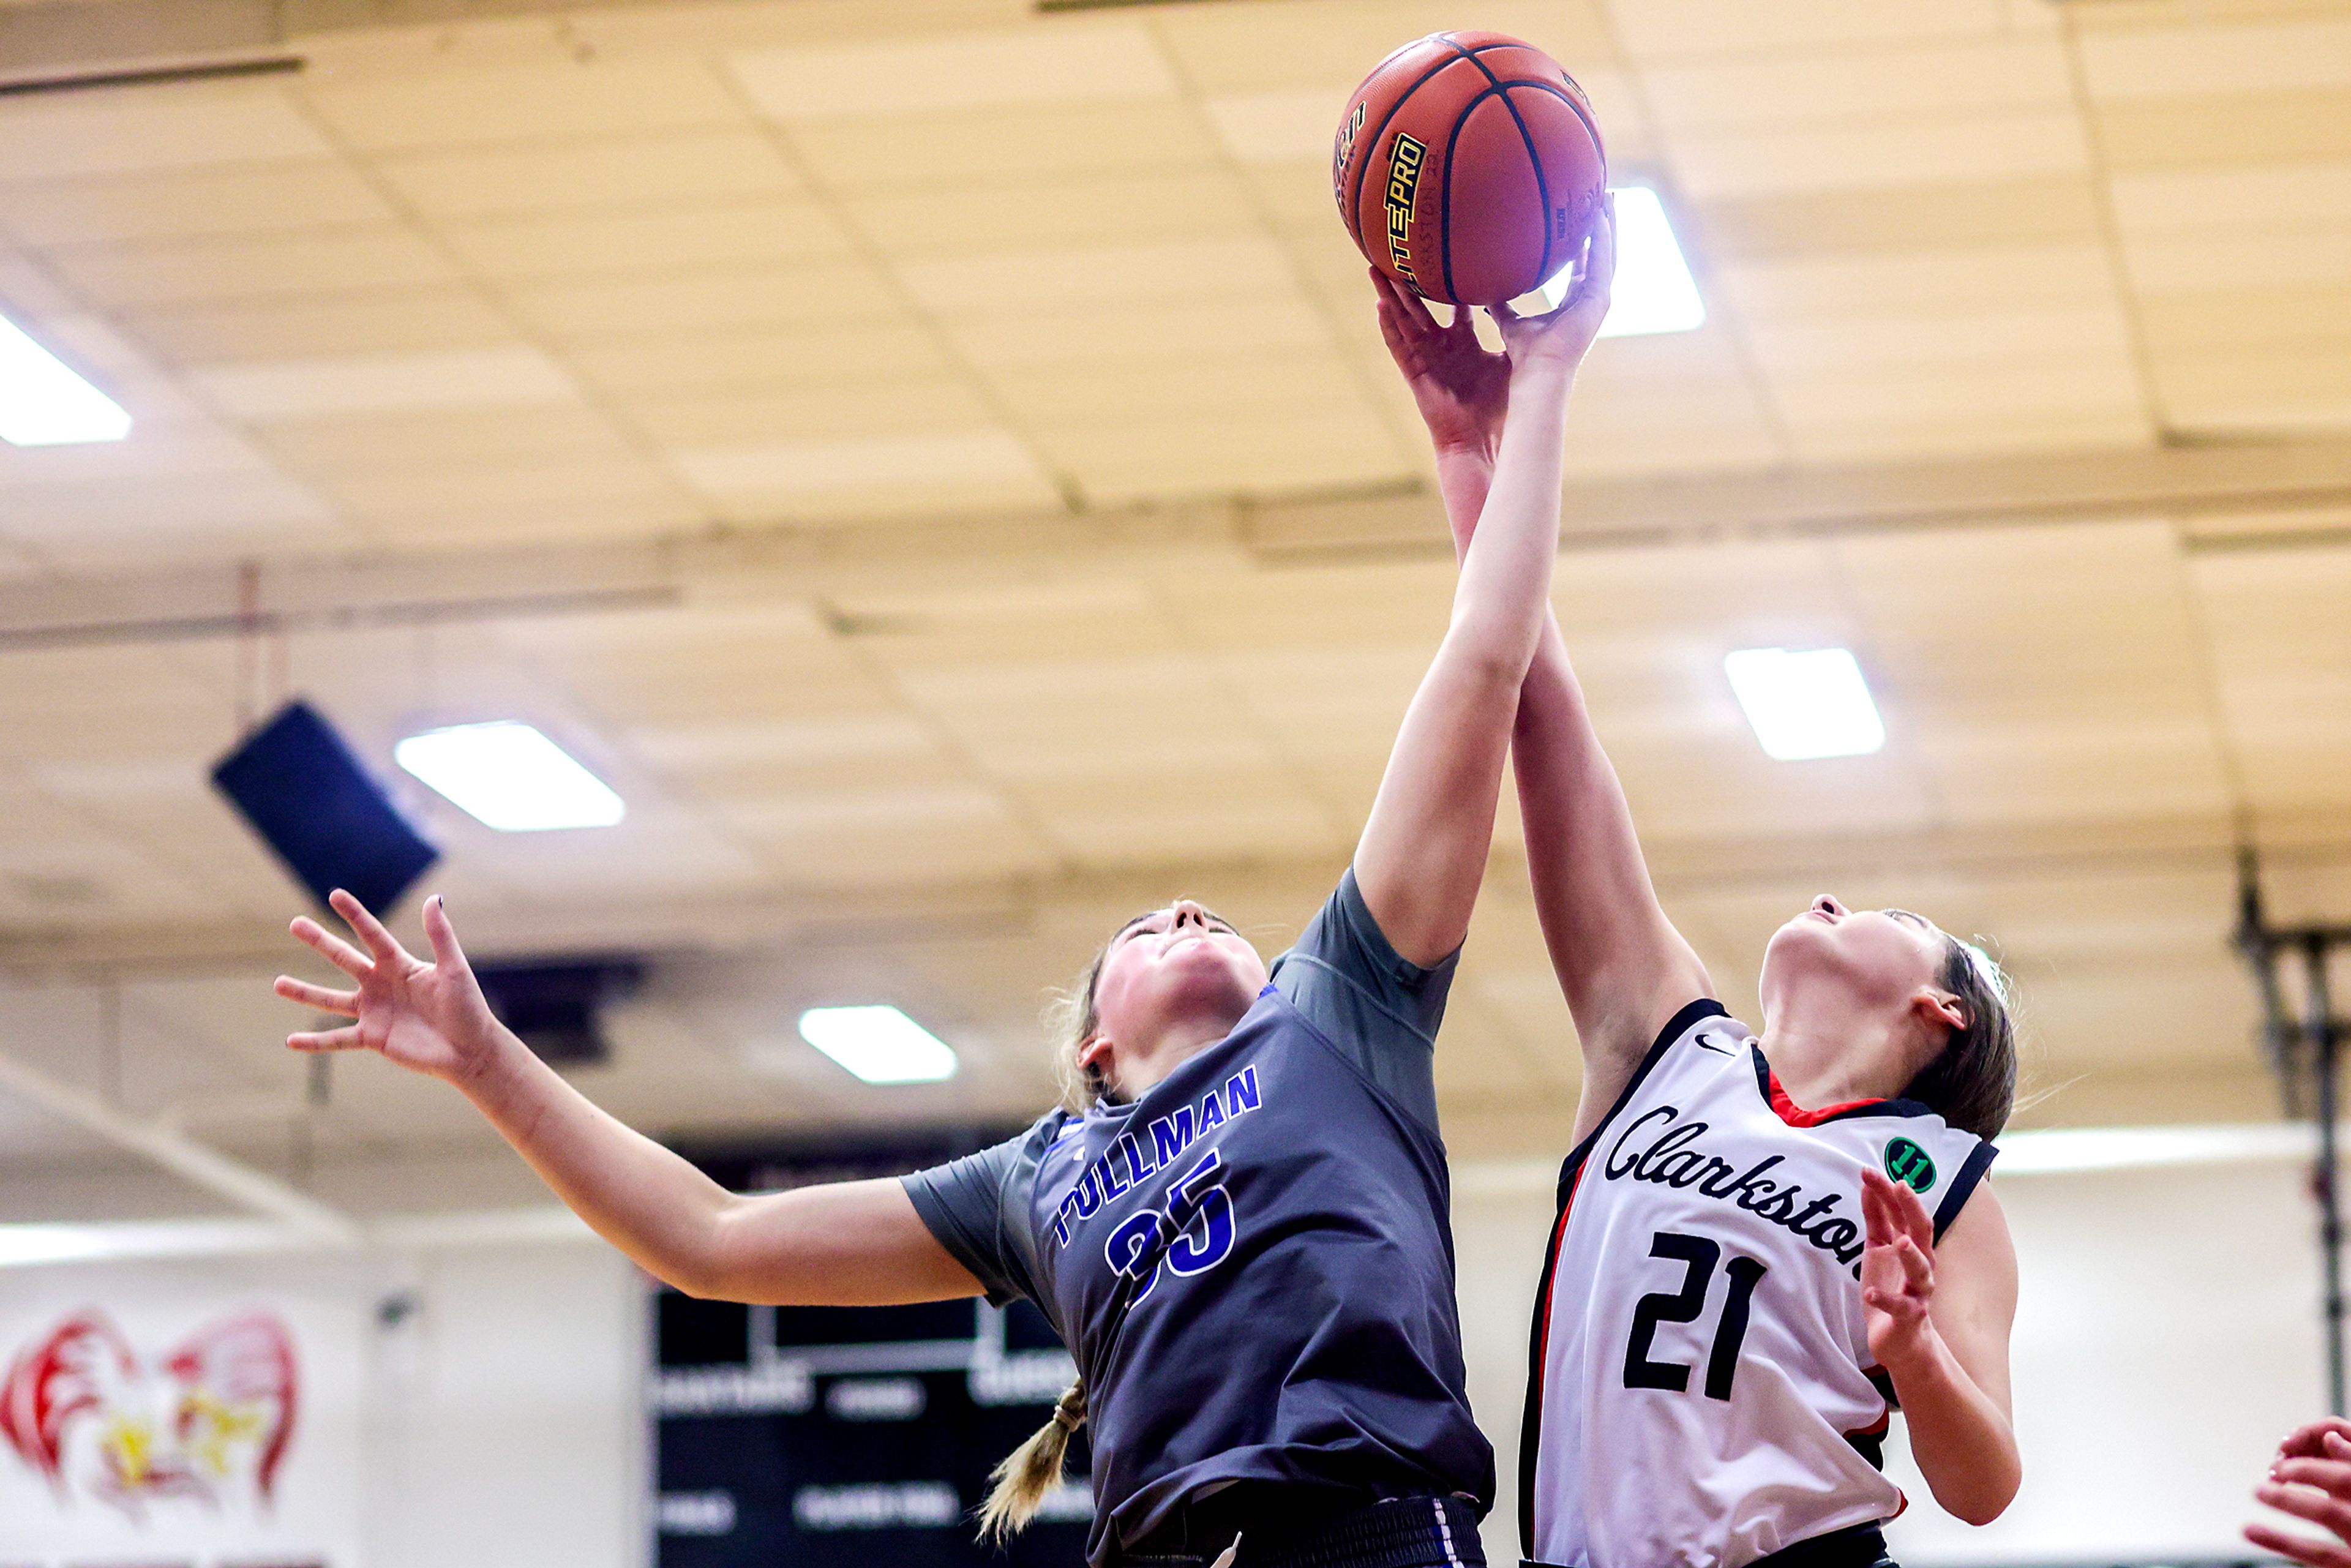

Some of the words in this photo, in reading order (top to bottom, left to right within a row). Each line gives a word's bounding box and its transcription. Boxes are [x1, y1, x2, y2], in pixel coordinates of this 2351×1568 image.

[1104, 1147, 1236, 1311] 35
[1891, 1144, 1929, 1188] 11
[1622, 1231, 1768, 1402] 21
